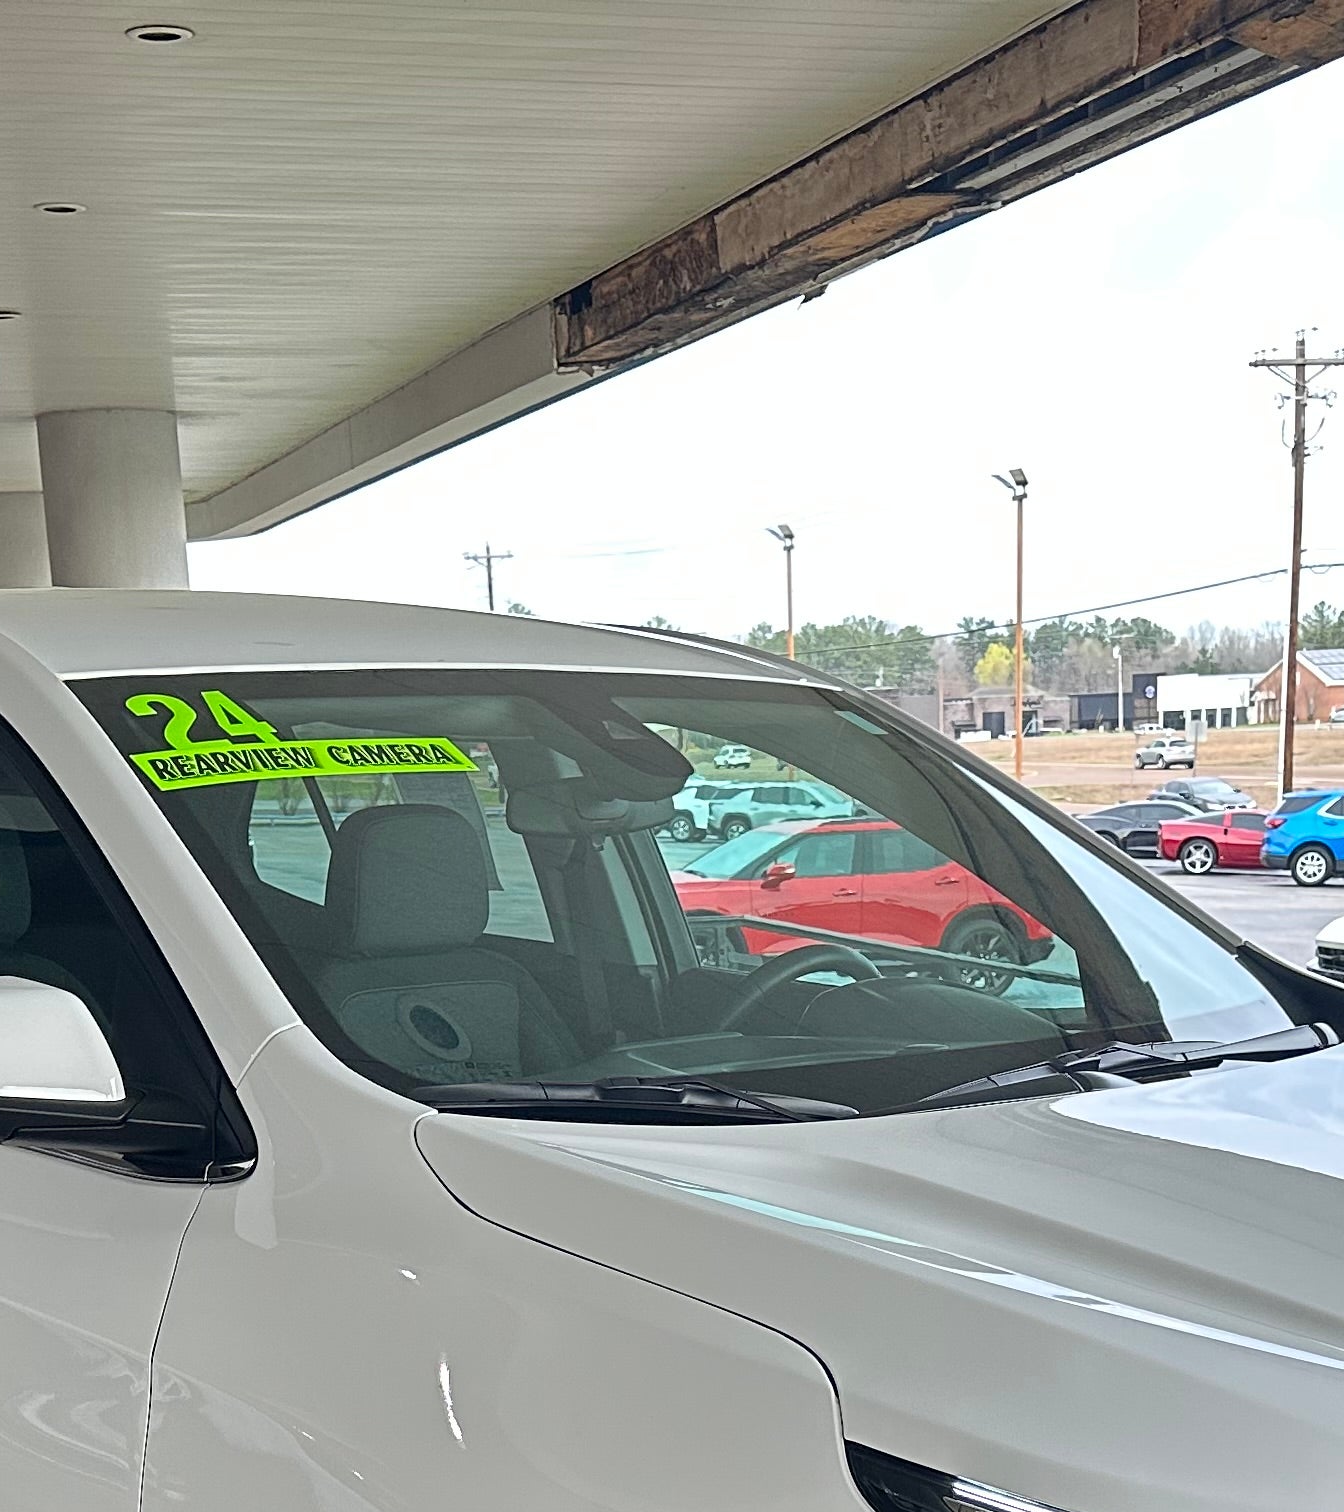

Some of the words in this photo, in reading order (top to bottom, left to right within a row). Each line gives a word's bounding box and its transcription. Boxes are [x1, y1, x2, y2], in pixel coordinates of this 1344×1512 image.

[125, 690, 279, 750] 24
[147, 745, 315, 781] REARVIEW
[327, 743, 455, 767] CAMERA
